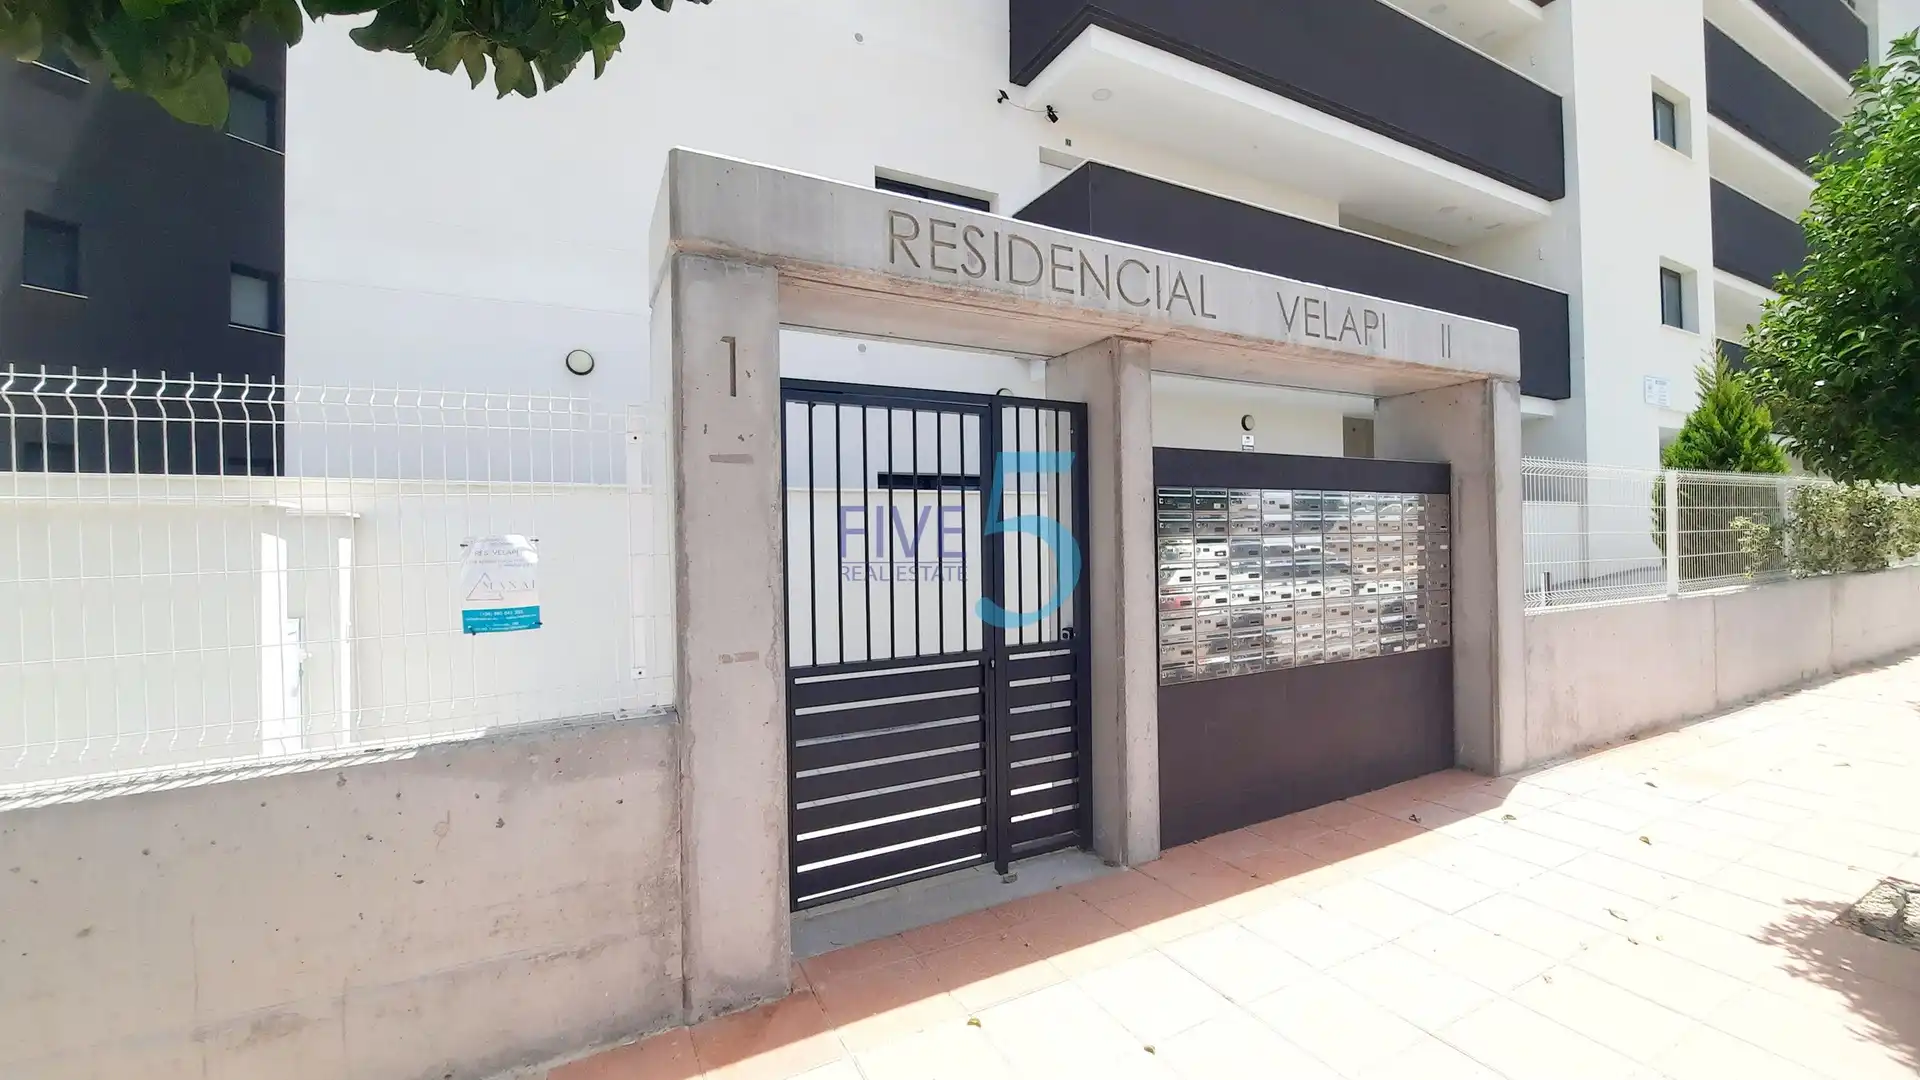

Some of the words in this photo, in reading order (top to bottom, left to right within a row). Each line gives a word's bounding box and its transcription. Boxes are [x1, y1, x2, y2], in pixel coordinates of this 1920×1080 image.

[889, 210, 1216, 320] RESIDENCIAL
[1276, 291, 1387, 349] VELAPI
[1441, 323, 1451, 358] II
[720, 336, 737, 397] 1
